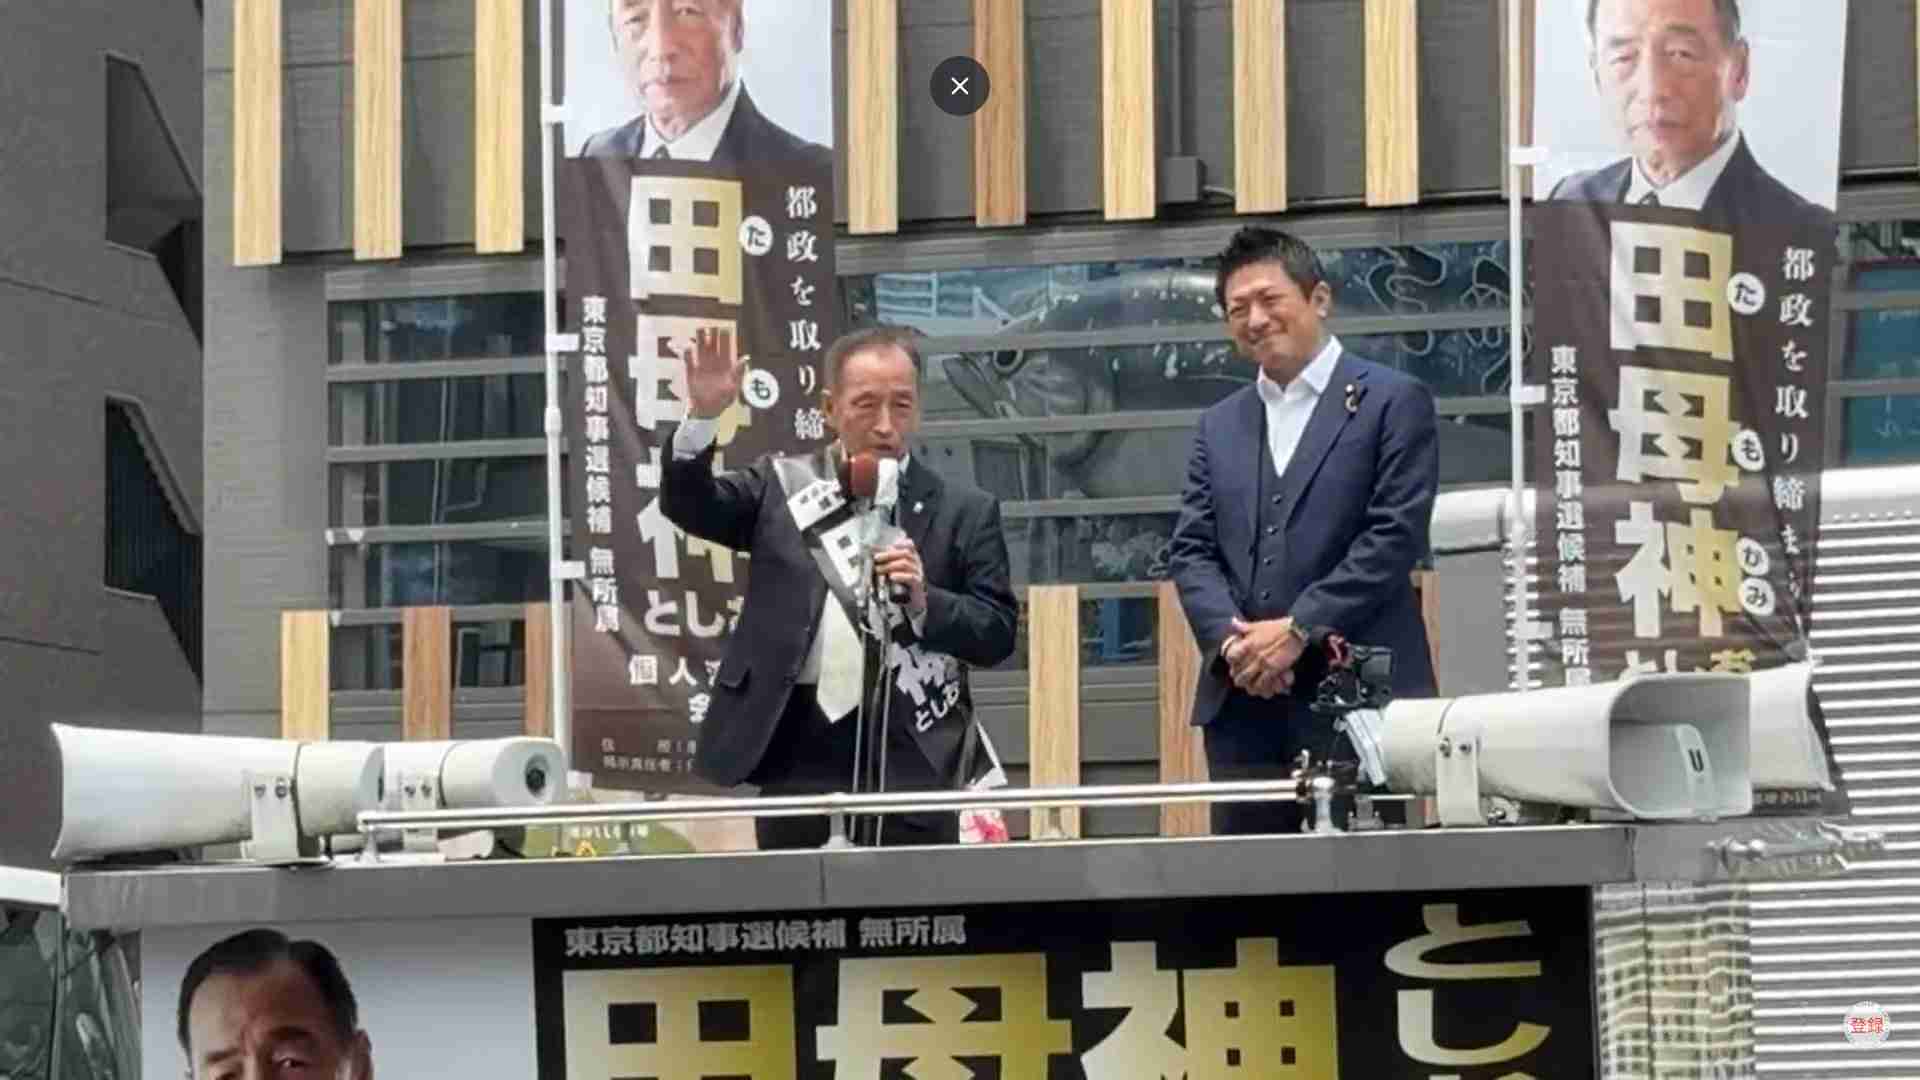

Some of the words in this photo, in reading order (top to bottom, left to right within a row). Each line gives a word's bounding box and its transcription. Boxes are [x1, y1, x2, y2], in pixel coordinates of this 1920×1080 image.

[582, 296, 612, 533] 東京都知事選候補
[1551, 346, 1586, 592] 東京都知事選候補
[1608, 221, 1742, 637] 田母神
[564, 918, 847, 957] 東京都知事選候補
[858, 914, 967, 947] 無所属
[1384, 904, 1551, 1080] とし
